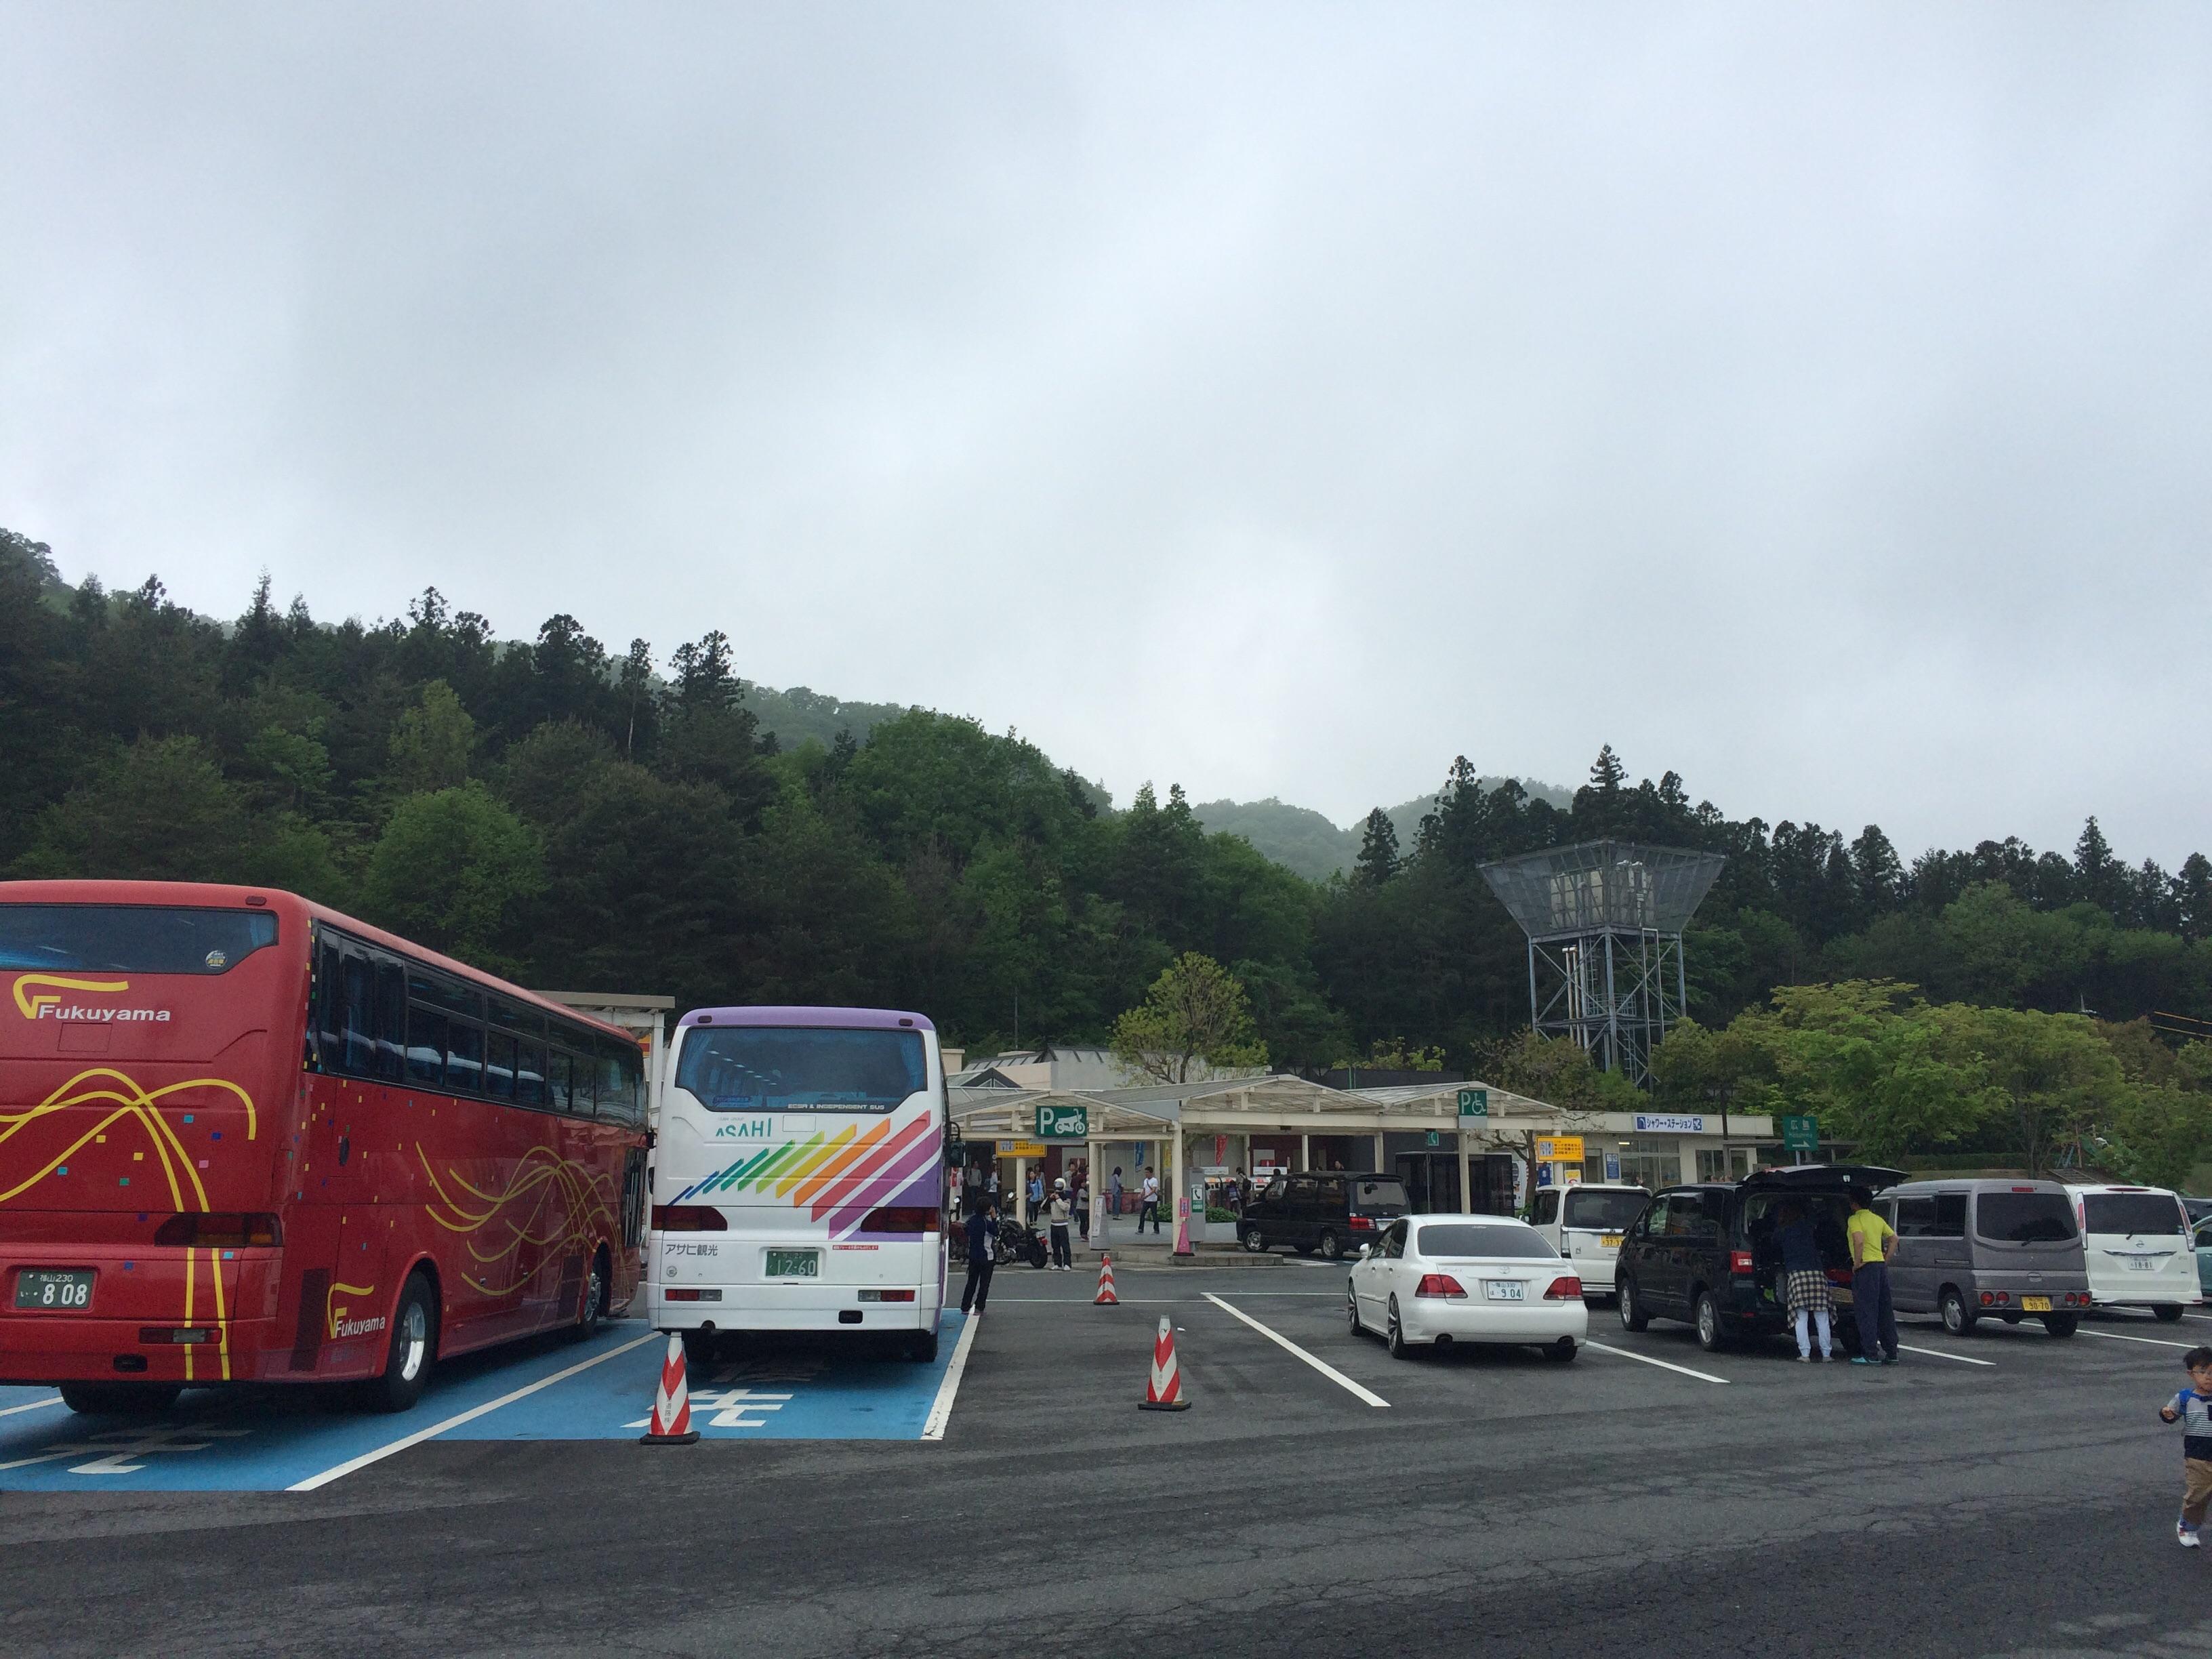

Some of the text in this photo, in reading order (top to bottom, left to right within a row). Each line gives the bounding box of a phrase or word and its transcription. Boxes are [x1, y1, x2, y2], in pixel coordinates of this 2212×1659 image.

[39, 1004, 171, 1021] Fukuyama
[1461, 1092, 1471, 1114] P
[716, 1118, 772, 1137] ASAHI
[1040, 1107, 1054, 1134] P
[665, 1244, 718, 1256] アサヒ観光
[334, 1316, 386, 1339] Fukuyama
